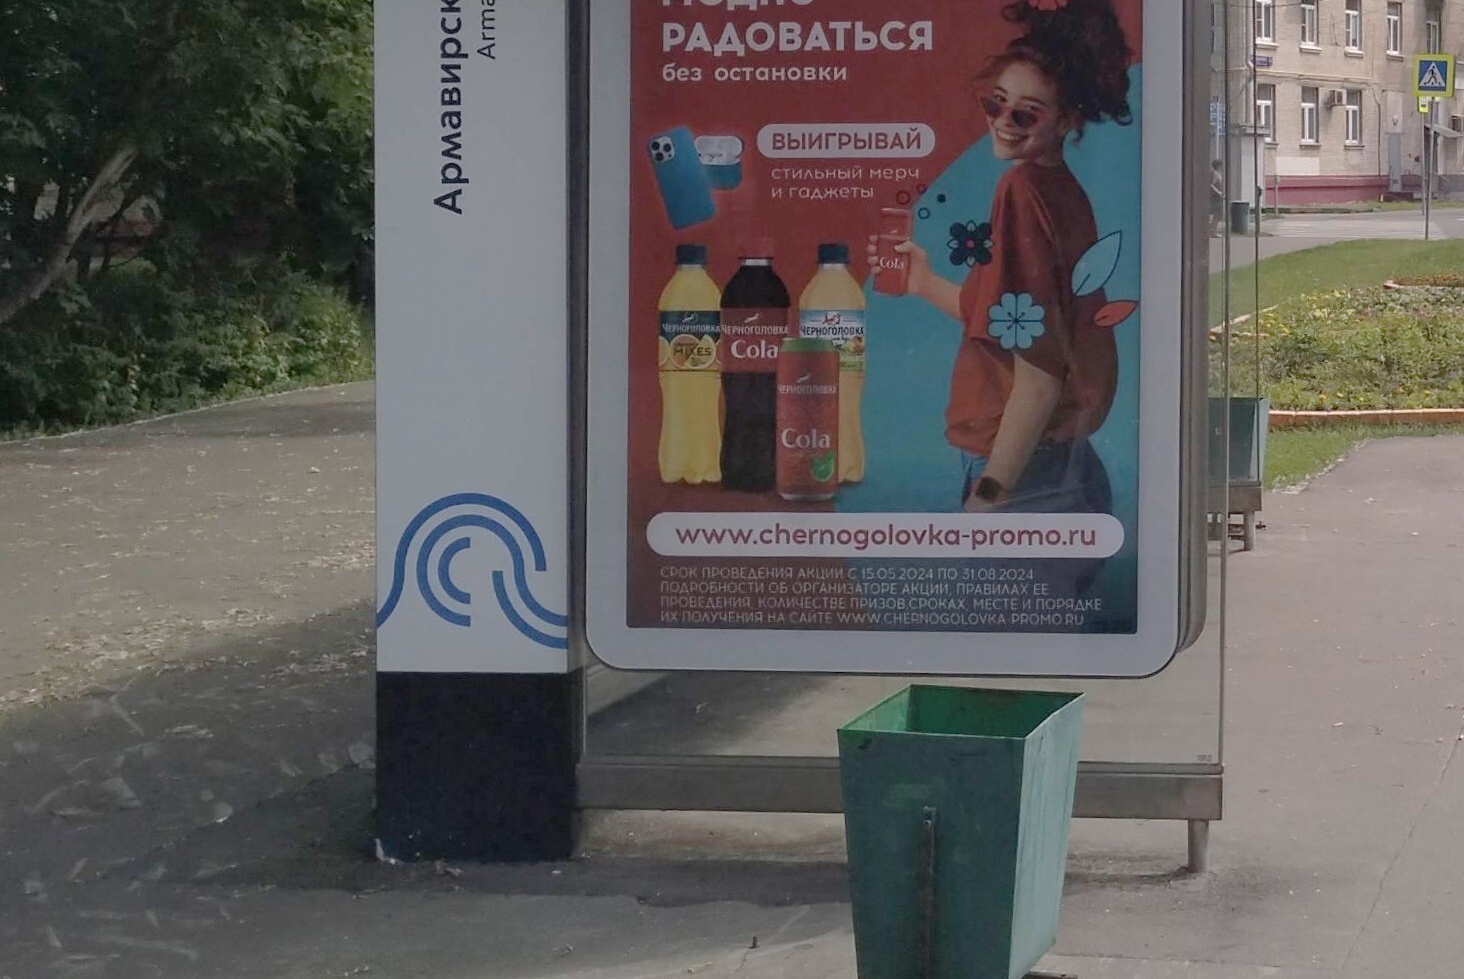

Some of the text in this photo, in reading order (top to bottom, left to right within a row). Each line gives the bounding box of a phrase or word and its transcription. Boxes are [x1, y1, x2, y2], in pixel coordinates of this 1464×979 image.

[661, 20, 934, 56] РАДОВАТЬСЯ
[661, 62, 848, 82] без остановки
[772, 127, 922, 151] ВЫИГРЫВАЙ
[771, 165, 920, 182] стильный мерч
[771, 186, 875, 201] и гаджеты
[880, 256, 904, 269] Cola
[731, 339, 779, 359] Cola
[781, 428, 831, 449] Cola
[675, 523, 1097, 551] www.chernogolovka-promo.ru
[661, 566, 698, 578] СРОК
[702, 567, 793, 580] ПРОВЕДЕНИЯ
[798, 567, 844, 580] АКЦИИ
[847, 567, 857, 580] С
[938, 567, 958, 580] ПО
[660, 581, 764, 594] ПОДРОБНОСТИ
[768, 582, 788, 594] ОБ
[792, 582, 897, 595] ОРГАНИЗАТОРЕ
[956, 583, 1029, 596] ПРАВИЛАХ
[1033, 583, 1049, 596] ЕЕ
[758, 596, 846, 610] КОЛИЧЕСТВЕ
[973, 598, 1019, 611] МЕСТЕ
[1022, 598, 1032, 611] И
[1036, 598, 1103, 612] ПОРЯДКЕ
[660, 611, 679, 623] ИХ
[682, 611, 763, 624] ПОЛУЧЕНИЯ
[767, 612, 785, 624] НА
[789, 610, 831, 624] САЙТЕ
